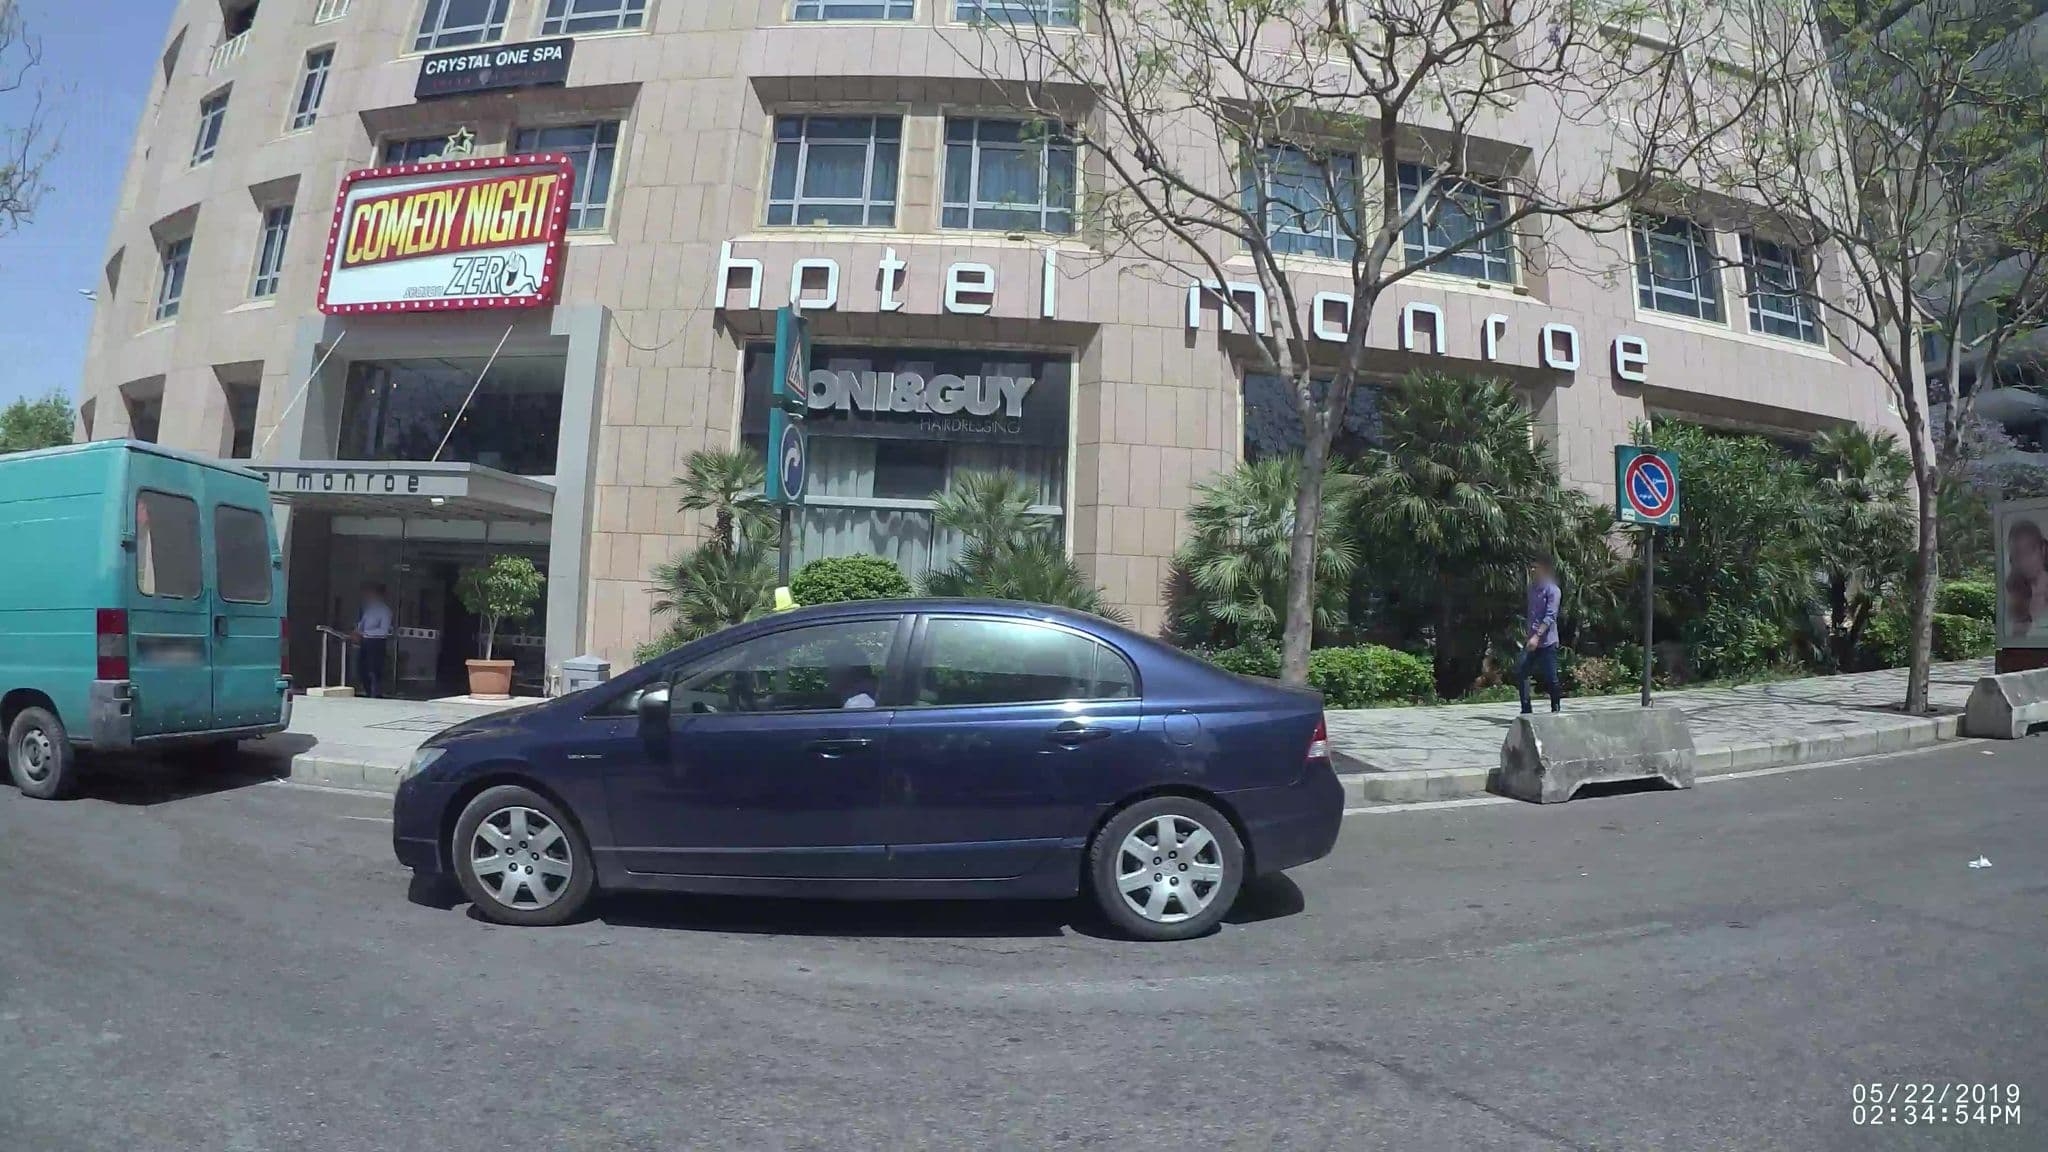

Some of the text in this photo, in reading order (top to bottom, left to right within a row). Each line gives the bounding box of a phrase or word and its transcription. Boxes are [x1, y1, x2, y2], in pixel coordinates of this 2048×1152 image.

[425, 45, 563, 75] CRYSTAL ONE SPA
[345, 174, 559, 264] COMEDY NIGHT
[444, 253, 530, 297] ZERO
[714, 240, 1649, 382] hotel monroe
[808, 368, 1036, 418] ONI&GUY
[297, 472, 419, 493] monroe
